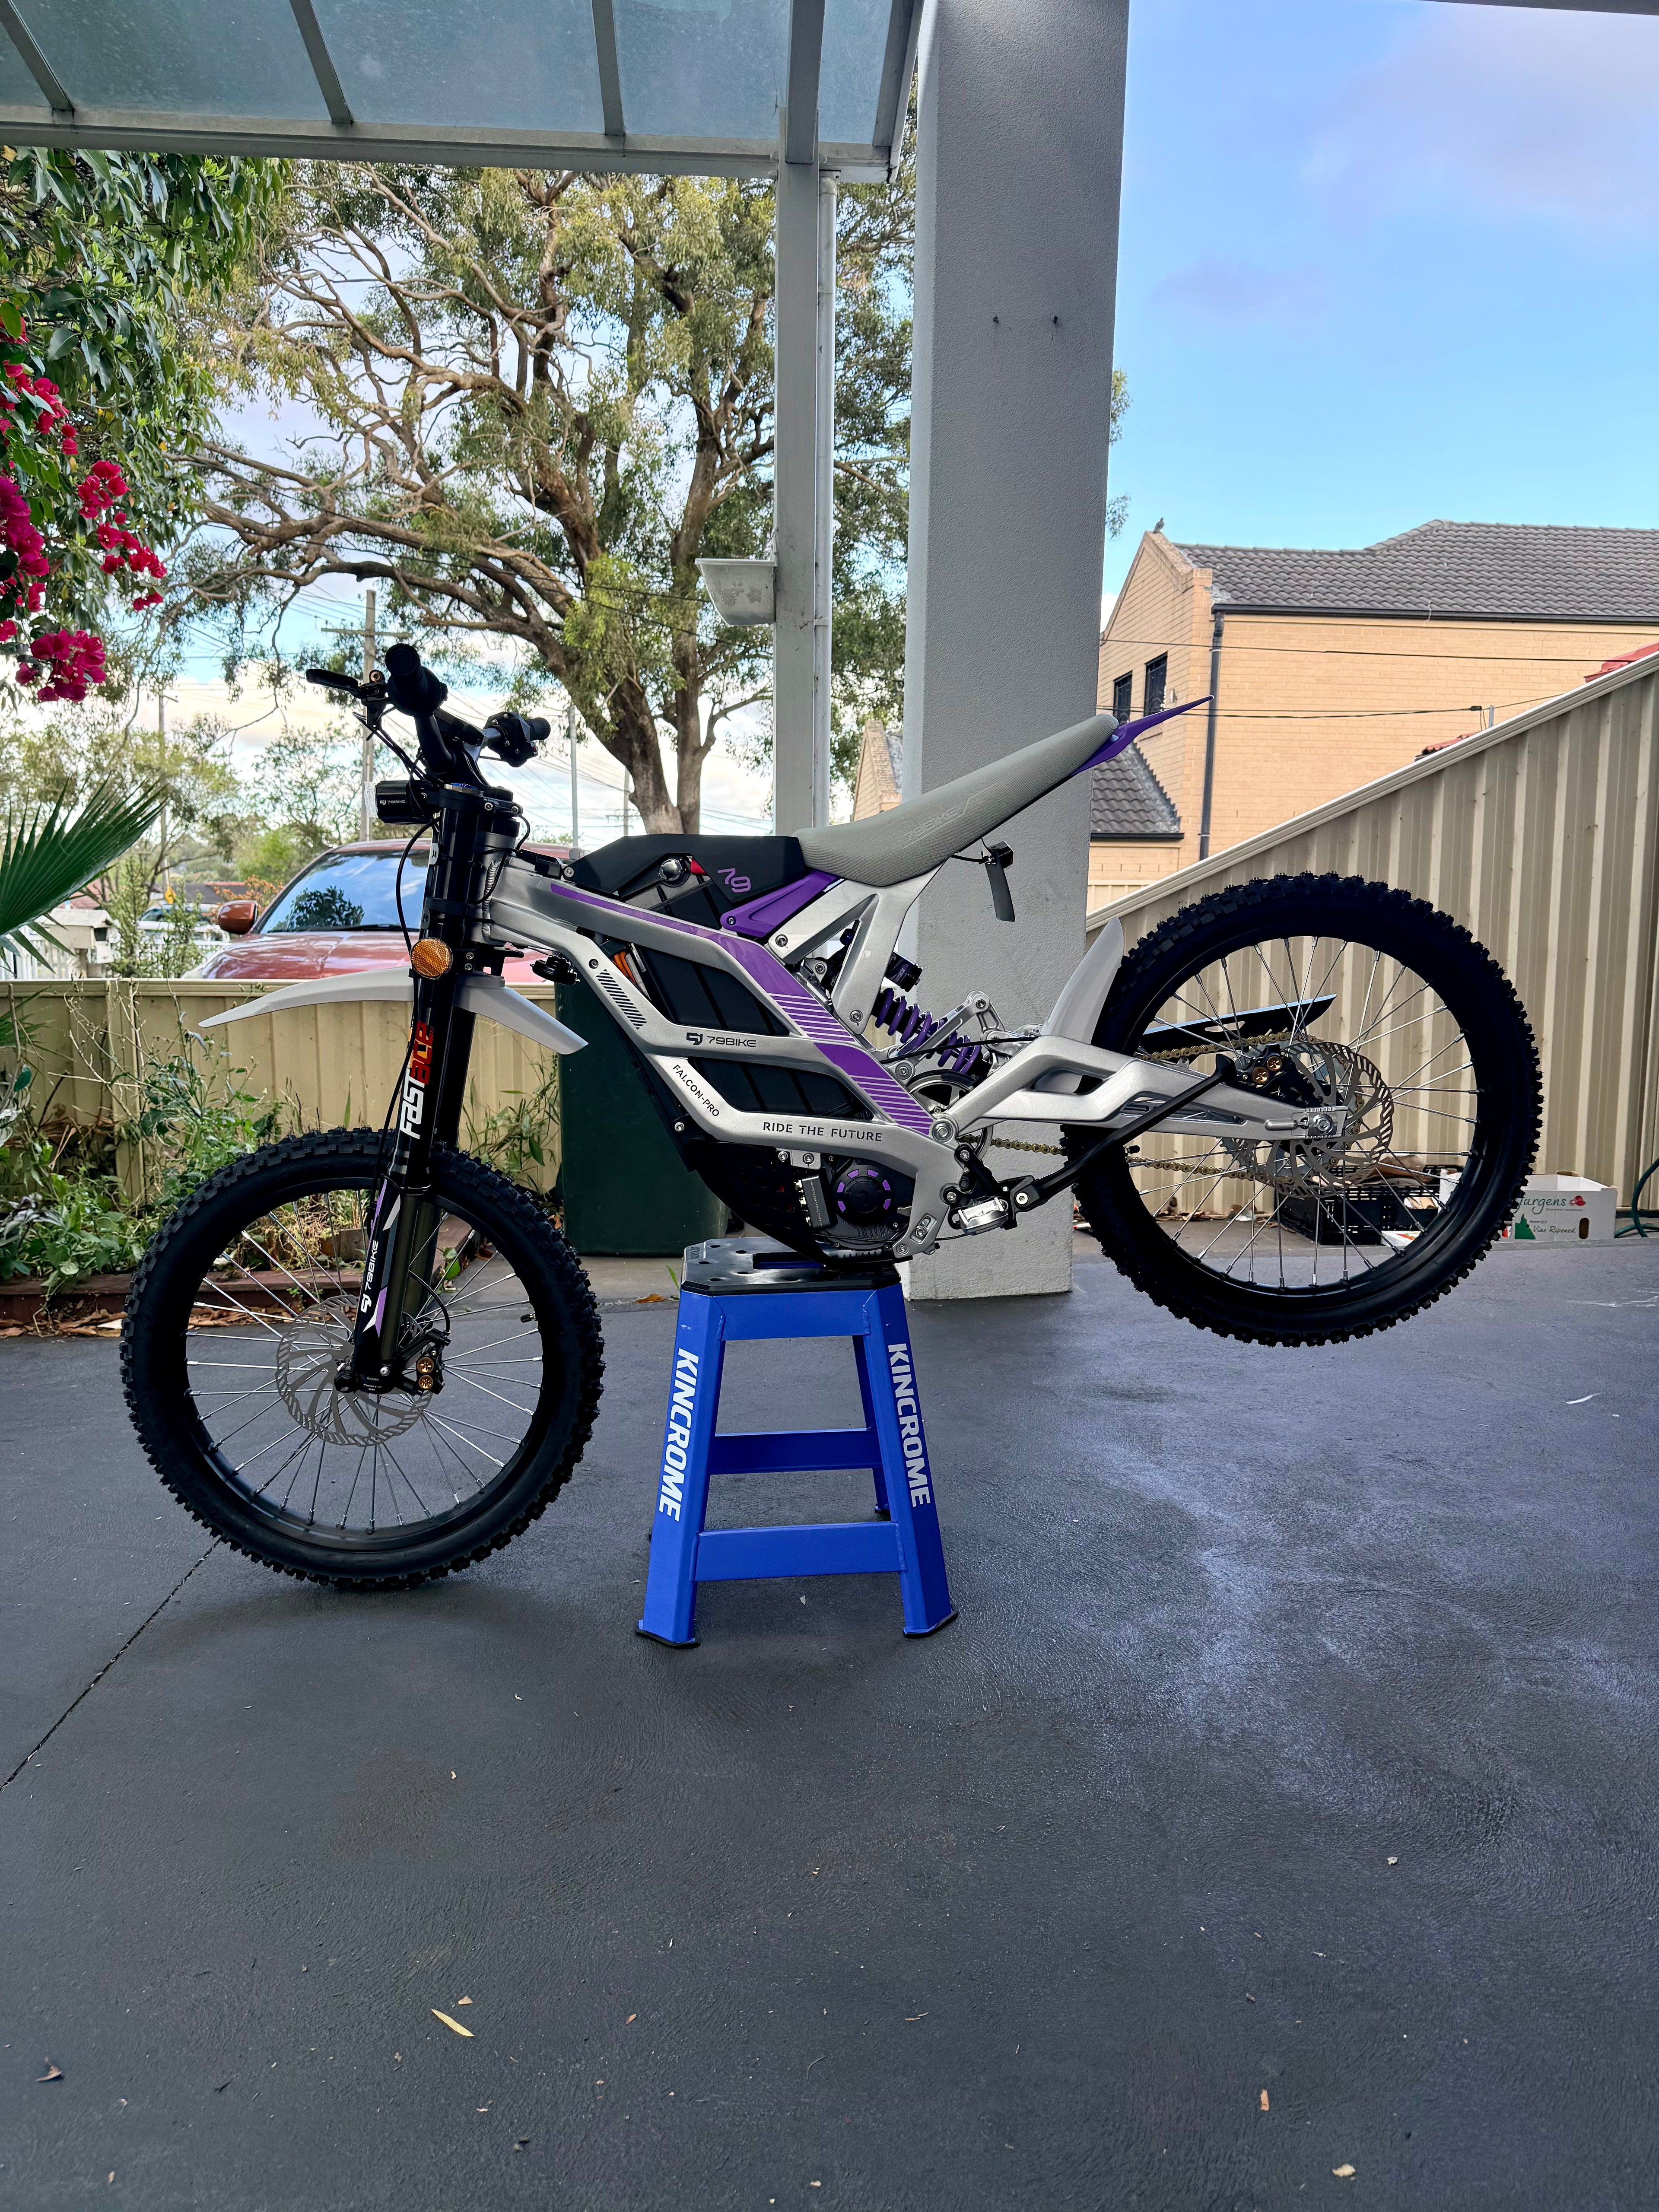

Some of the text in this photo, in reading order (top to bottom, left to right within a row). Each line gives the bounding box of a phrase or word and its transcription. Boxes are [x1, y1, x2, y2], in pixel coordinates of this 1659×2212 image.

[717, 868, 751, 893] 79
[706, 1036, 756, 1048] 79BIKE
[673, 1065, 719, 1116] FALCON-PRO
[763, 1122, 882, 1141] RIDE THE FUTURE
[1549, 1226, 1576, 1234] Ripened
[365, 1239, 378, 1290] 79BIKE
[659, 1348, 699, 1522] KINCROME
[888, 1343, 931, 1507] KINCROME
